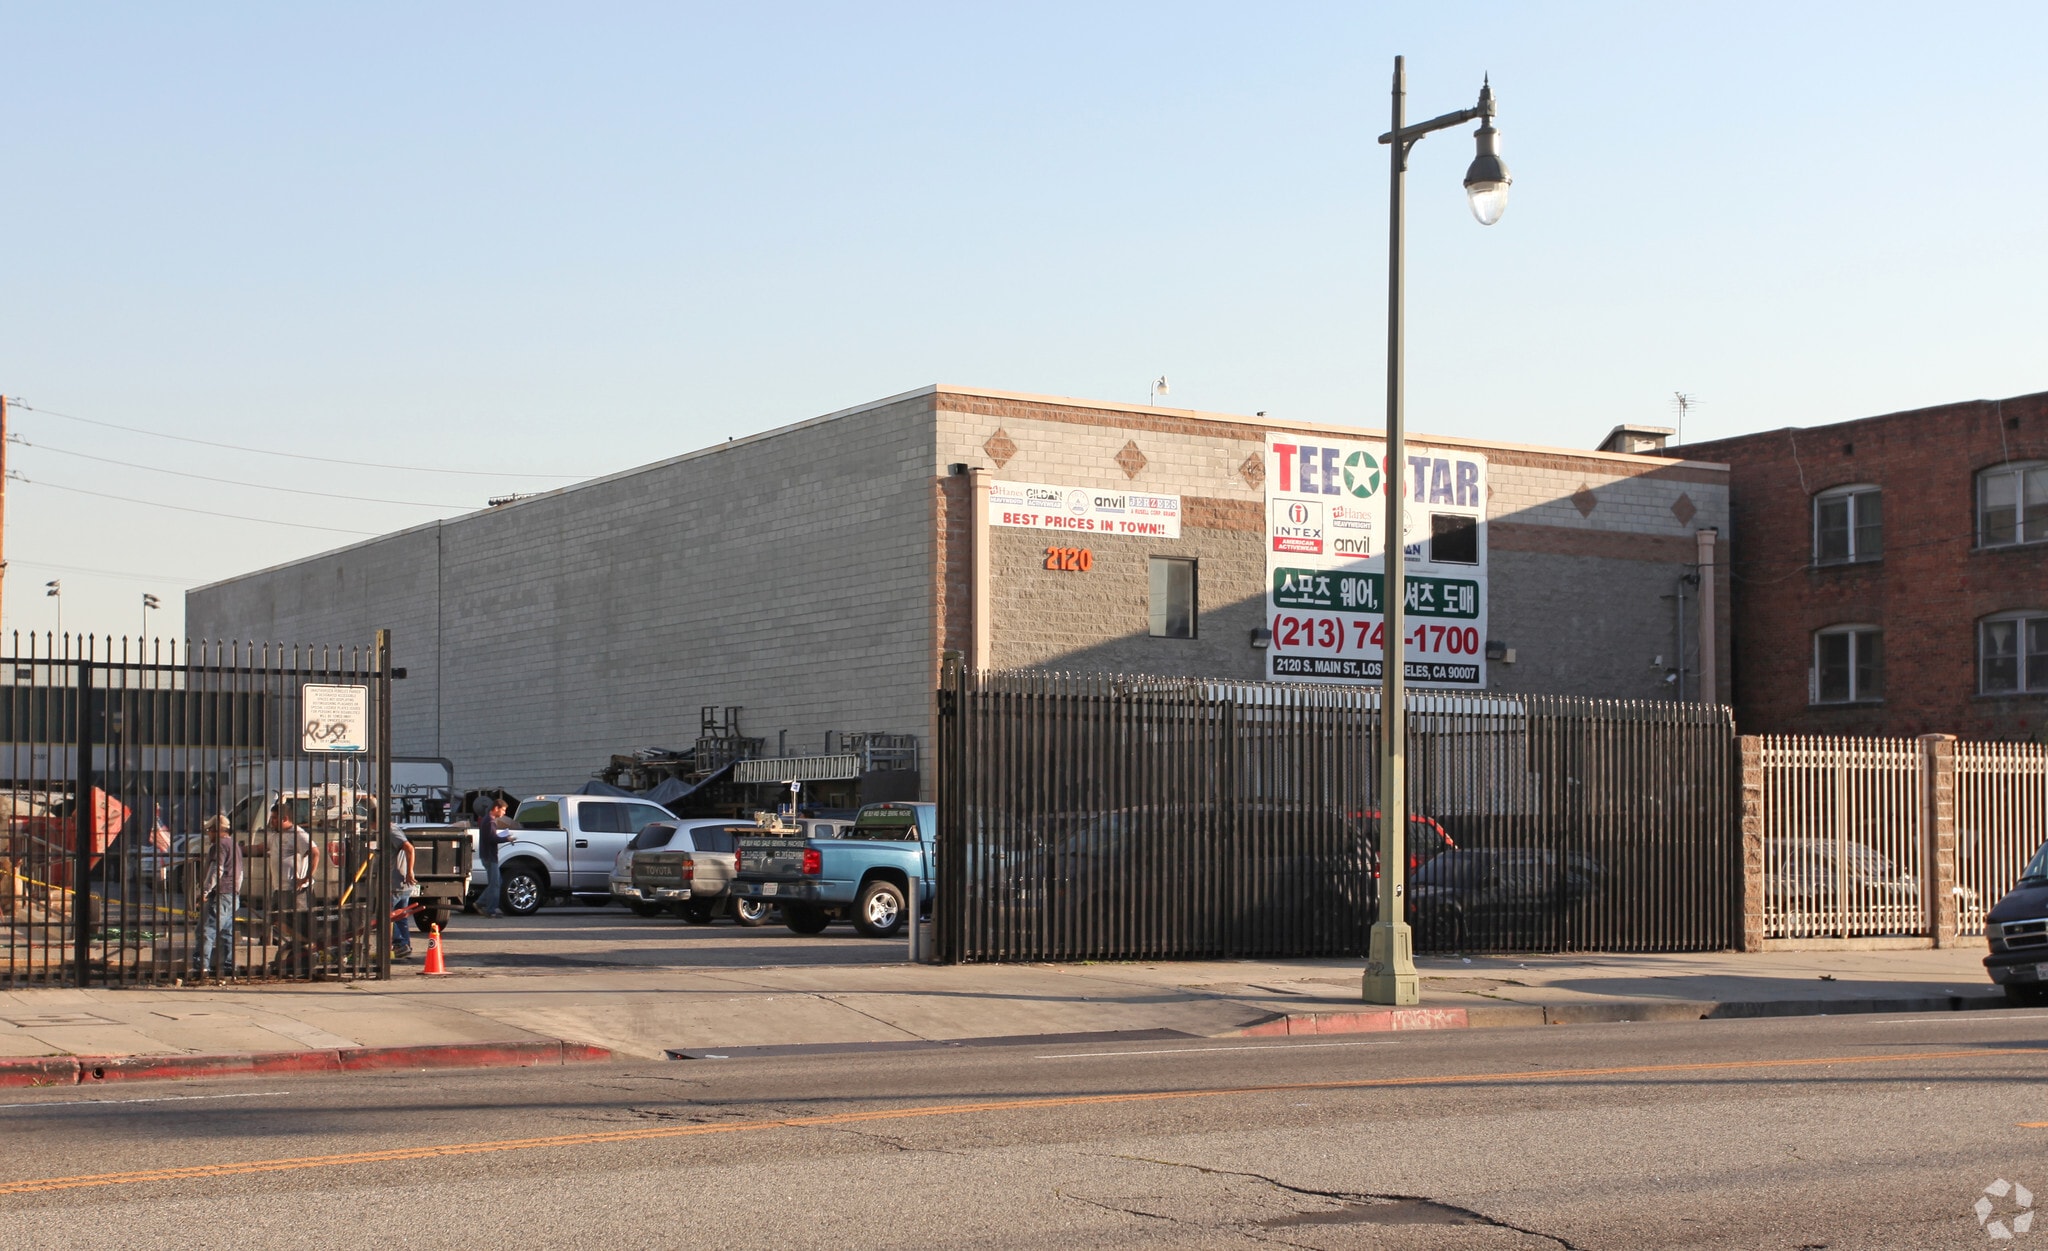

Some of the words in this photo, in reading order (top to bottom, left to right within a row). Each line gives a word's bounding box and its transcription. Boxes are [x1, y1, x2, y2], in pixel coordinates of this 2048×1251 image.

[1273, 443, 1341, 495] TEE
[1383, 455, 1479, 507] TAR
[1026, 488, 1063, 501] GILDAN
[1094, 496, 1126, 508] anvil
[1129, 496, 1177, 510] JERZEES
[1345, 507, 1371, 519] Hanes
[1003, 512, 1039, 525] BEST
[1045, 515, 1095, 530] PRICES
[1101, 520, 1113, 531] IN
[1119, 521, 1165, 535] TOWN!!
[1334, 520, 1371, 530] HEAVYWEIGHT
[1276, 526, 1321, 538] INTEX
[1278, 543, 1319, 552] ACTIVEWEAR
[1334, 536, 1370, 553] anvil
[1046, 546, 1093, 572] 2120
[1280, 573, 1331, 605] 스포츠
[1340, 577, 1378, 610] 웨어,
[1443, 585, 1474, 613] 도매
[1273, 613, 1345, 654] (213)
[1353, 621, 1479, 655] 74-1700
[1276, 659, 1301, 671] 2120
[1303, 660, 1313, 673] S.
[1315, 661, 1341, 674] MAIN
[1362, 663, 1381, 676] LOS
[1404, 664, 1431, 680] ELES,
[1433, 666, 1447, 678] CA
[1448, 667, 1476, 680] 90007
[645, 866, 672, 876] TOYOTA
